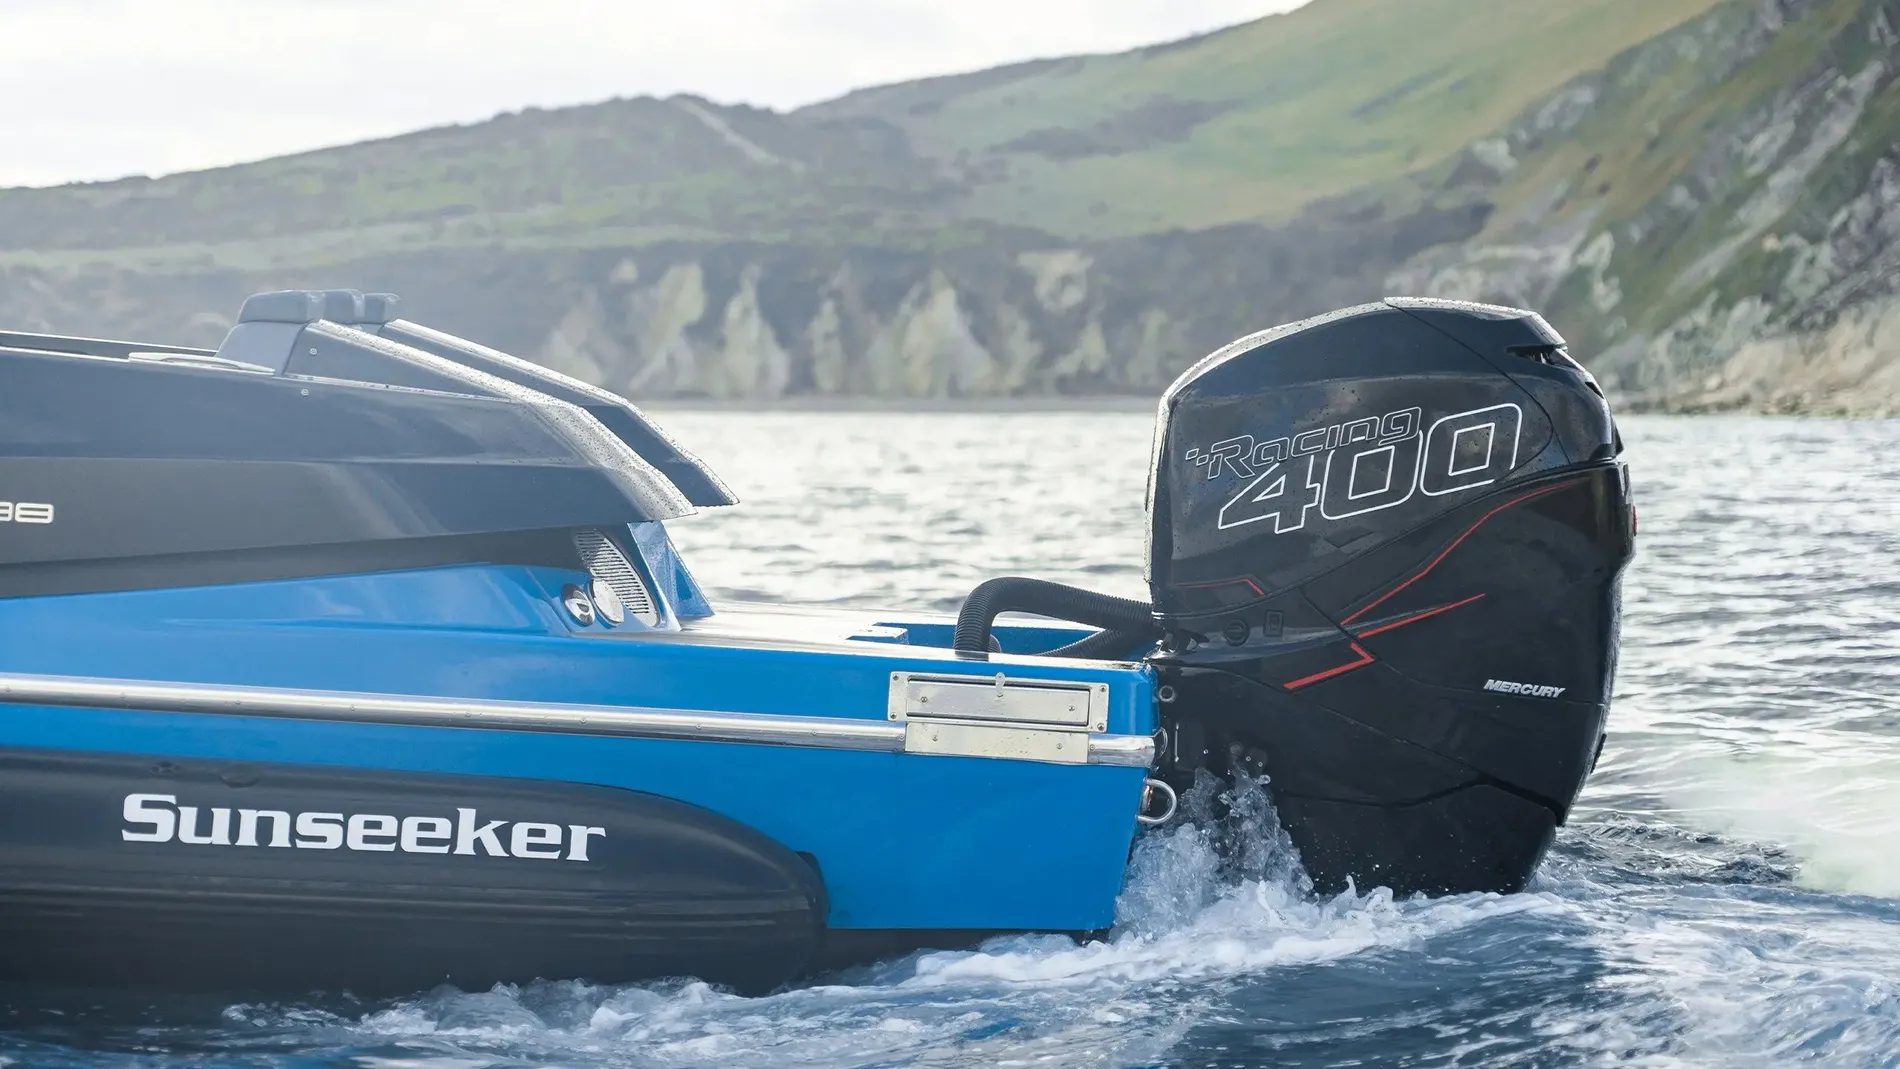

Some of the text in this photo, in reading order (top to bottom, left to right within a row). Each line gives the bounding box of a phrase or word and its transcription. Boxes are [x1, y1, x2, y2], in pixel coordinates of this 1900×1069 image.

[1205, 406, 1422, 479] Racing
[1217, 403, 1523, 534] 400
[1483, 679, 1566, 698] MERCURY
[121, 792, 606, 862] Sunseeker
